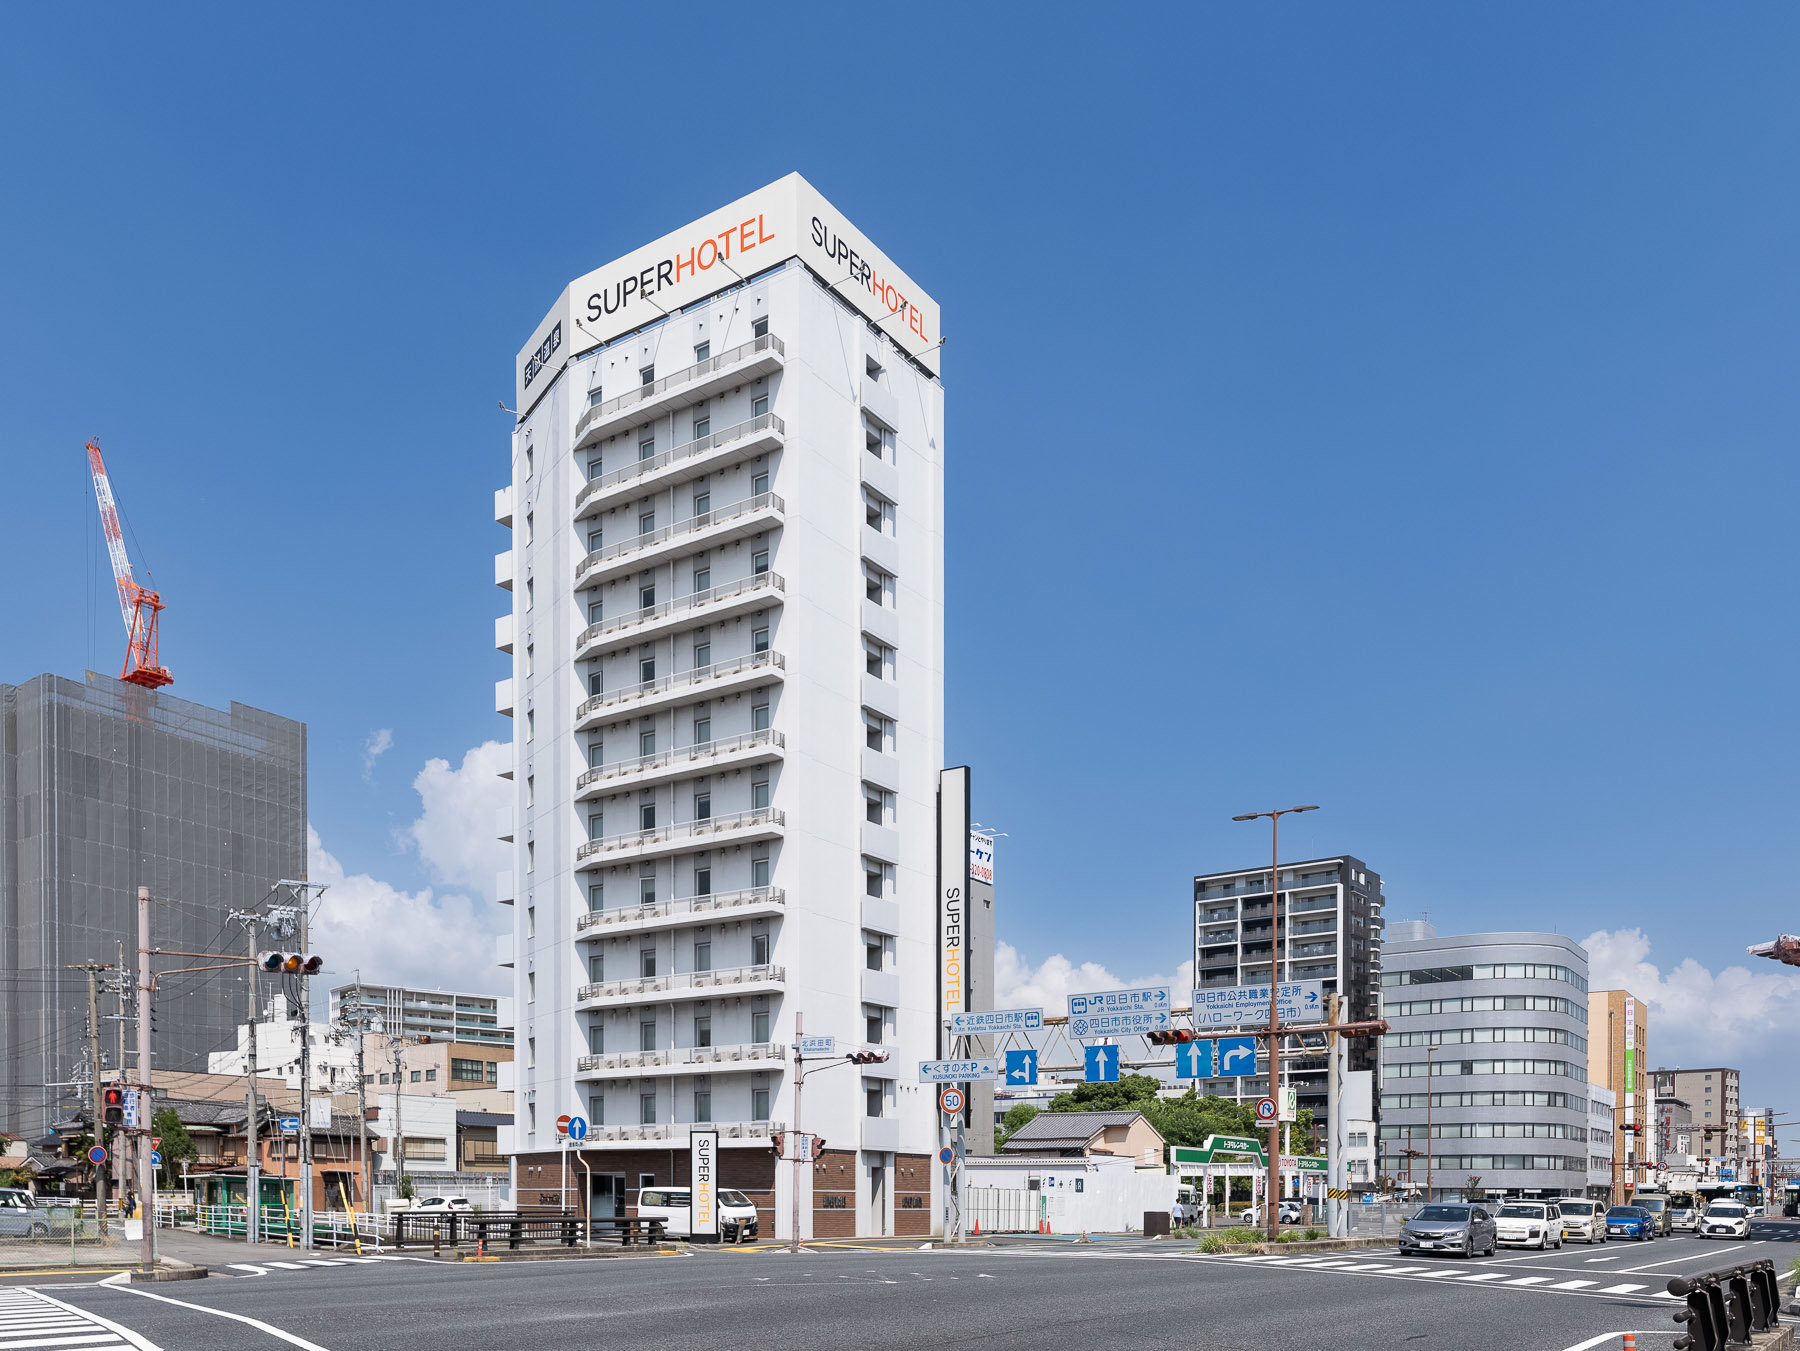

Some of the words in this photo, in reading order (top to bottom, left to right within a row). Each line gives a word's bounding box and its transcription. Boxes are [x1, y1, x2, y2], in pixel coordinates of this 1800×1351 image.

[586, 214, 775, 323] SUPERHOTEL
[811, 215, 929, 343] SUPERHOTEL
[946, 887, 960, 1012] SUPERHOTEL
[1206, 1002, 1234, 1010] Yokkaichi
[966, 1012, 1024, 1026] 近鉄四日市駅
[1089, 1013, 1153, 1028] 四日市市役所
[1094, 1027, 1120, 1035] Yokkaichi
[1120, 1026, 1131, 1034] City
[945, 1095, 959, 1107] 50
[1281, 1158, 1297, 1167] TOYOTA
[698, 1139, 710, 1228] SUPERHOTEL
